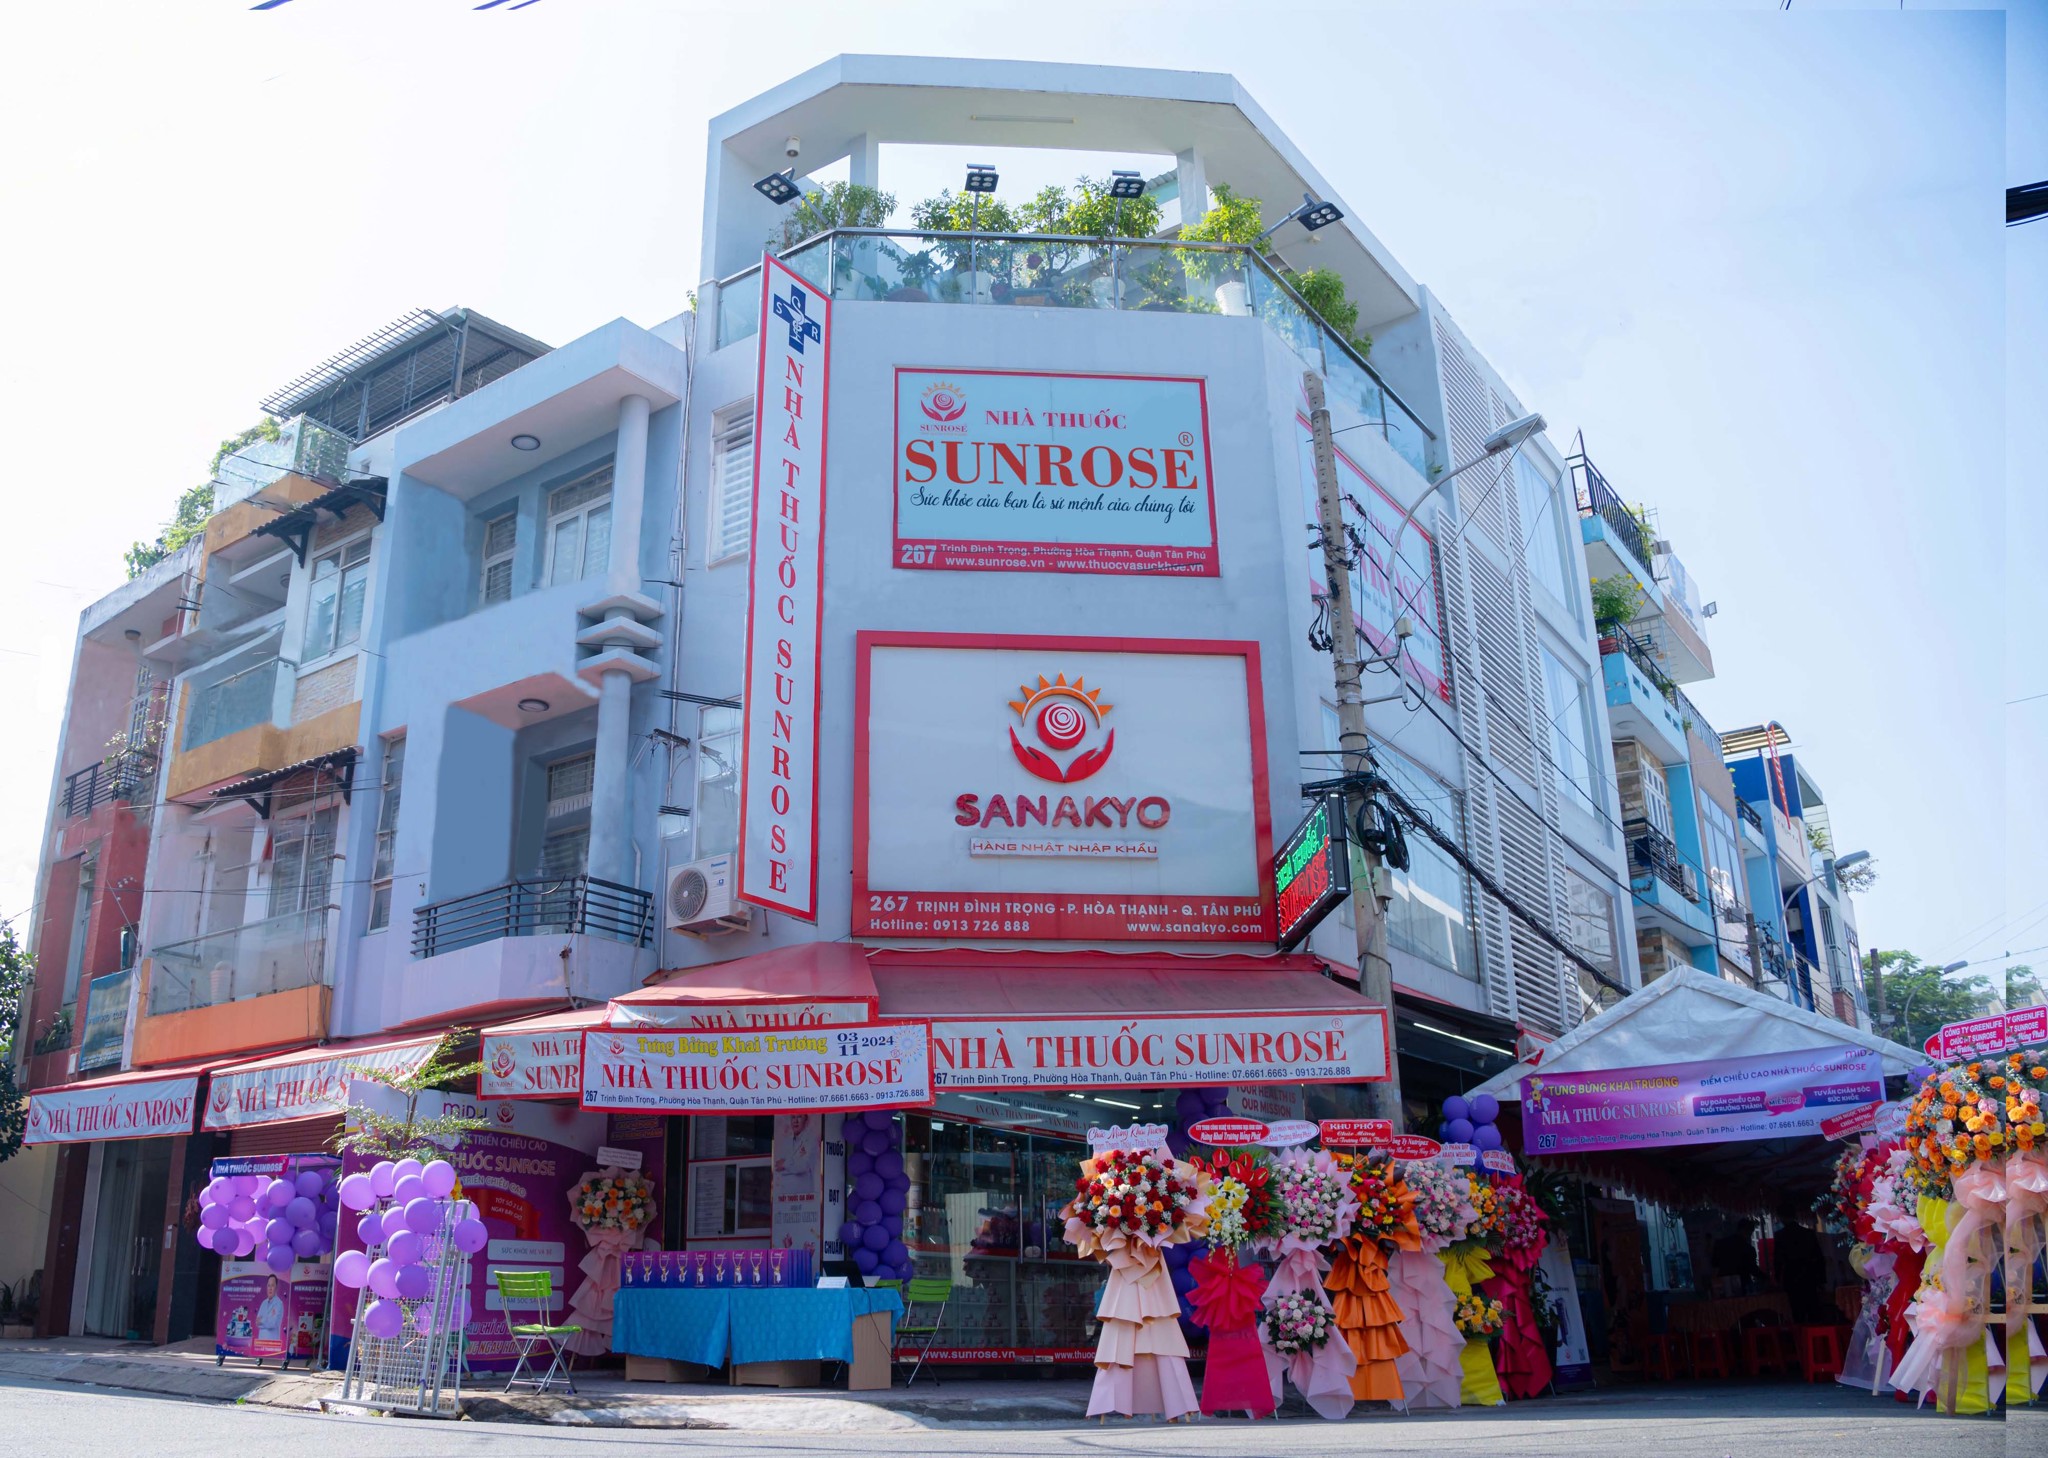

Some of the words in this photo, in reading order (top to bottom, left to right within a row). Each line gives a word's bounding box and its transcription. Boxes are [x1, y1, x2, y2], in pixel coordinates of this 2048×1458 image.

[783, 354, 806, 452] NHÀ
[986, 408, 1036, 428] NHÀ
[1043, 408, 1127, 431] THUỐC
[905, 438, 1198, 490] SUNROSE
[910, 486, 940, 508] Sức
[942, 488, 974, 508] khỏe
[976, 492, 1001, 508] của
[1004, 490, 1029, 510] bạn
[1032, 491, 1046, 509] là
[1050, 494, 1066, 510] sứ
[1067, 494, 1104, 512] mệnh
[1107, 494, 1131, 512] của
[1134, 494, 1173, 524] chúng
[1178, 495, 1196, 514] tôi
[776, 456, 802, 627] THUỐC
[901, 544, 937, 564] 267
[940, 544, 967, 554] Trịnh
[970, 544, 994, 554] Đình
[997, 545, 1030, 556] Trọng,
[1032, 545, 1072, 558] Phường
[1074, 546, 1094, 556] Hòa
[1097, 548, 1133, 559] Thạnh,
[1136, 548, 1162, 560] Quận
[1164, 549, 1183, 558] Tân
[1186, 548, 1206, 560] Phú
[945, 555, 1045, 569] www.sunrose.vn
[768, 637, 794, 895] SUNROSE
[954, 793, 1172, 829] SANAKYO
[972, 842, 1017, 852] HÀNG
[1021, 842, 1064, 854] NHẬT
[1068, 843, 1110, 855] NHẬP
[1115, 842, 1158, 854] KHẨU
[870, 895, 909, 912] 267
[916, 902, 960, 916] TRỊNH
[963, 898, 1002, 914] ĐÌNH
[1004, 902, 1056, 917] TRỌNG
[1067, 904, 1080, 916] P.
[1083, 899, 1116, 916] HÒA
[1118, 904, 1168, 918] THẠNH
[1181, 904, 1198, 917] Q.
[1200, 902, 1230, 917] TÂN
[1231, 901, 1260, 917] PHÚ
[871, 918, 929, 932] Hotline:
[933, 920, 969, 932] 0913
[972, 920, 1000, 932] 726
[1004, 920, 1030, 932] 888
[1126, 922, 1262, 936] www.sanakyo.com
[2012, 1010, 2045, 1023] GREENLIFE
[1961, 1026, 1970, 1034] TY
[1970, 1020, 2003, 1033] GREENLIFE
[2014, 1021, 2039, 1033] SUNROSE
[636, 1036, 676, 1057] Tưng
[721, 1036, 761, 1053] Khai
[764, 1035, 828, 1054] Trương
[837, 1032, 858, 1042] 03
[862, 1036, 895, 1047] 2024
[932, 1028, 1015, 1070] NHÀ
[1026, 1021, 1164, 1068] THUỐC
[1174, 1029, 1347, 1066] SUNROSE
[1972, 1032, 1997, 1042] SUNROSE
[531, 1036, 560, 1058] NHÀ
[839, 1044, 860, 1056] 11
[524, 1064, 579, 1090] SUNR
[602, 1060, 654, 1089] NHÀ
[660, 1056, 758, 1090] THUỐC
[766, 1058, 903, 1090] SUNROSE
[951, 1074, 974, 1085] Trịnh
[1001, 1074, 1030, 1086] Trọng,
[1033, 1072, 1069, 1084] Phường
[1071, 1072, 1088, 1082] Hòa
[1090, 1072, 1122, 1084] Thạnh,
[1124, 1072, 1148, 1083] Quận
[1150, 1070, 1167, 1080] Tân
[1169, 1070, 1187, 1080] Phú
[1195, 1070, 1230, 1080] Hotline:
[1231, 1068, 1288, 1079] 07.6661.6663
[1295, 1066, 1351, 1078] 0913.726.888
[1751, 1070, 1768, 1079] CAO
[1770, 1064, 1790, 1076] NHÀ
[1791, 1063, 1822, 1073] THUỐC
[1823, 1063, 1866, 1072] SUNROSE
[234, 1079, 268, 1114] NHÀ
[274, 1065, 336, 1109] THUỐC
[1258, 1086, 1288, 1102] HEALTH
[1609, 1082, 1634, 1092] KHAI
[586, 1090, 598, 1102] 267
[600, 1094, 616, 1104] Trịnh
[635, 1095, 656, 1106] Trọng,
[702, 1096, 728, 1106] Thạnh,
[730, 1096, 749, 1106] Quận
[750, 1096, 766, 1105] Tân
[768, 1095, 782, 1104] Phú
[788, 1096, 818, 1104] Hotline:
[819, 1093, 870, 1103] 07.6661.6663
[876, 1088, 925, 1100] 0913.726.888
[46, 1102, 71, 1134] NHÀ
[76, 1094, 122, 1132] THUỐC
[124, 1096, 192, 1128] SUNROSE
[1242, 1098, 1258, 1112] OUR
[1260, 1101, 1292, 1118] MISSION
[1542, 1104, 1571, 1126] NHÀ
[1572, 1099, 1620, 1124] THUỐC
[1623, 1098, 1688, 1120] SUNROSE
[1354, 1120, 1374, 1130] PHỐ
[1740, 1124, 1767, 1132] Hotline:
[528, 1140, 548, 1152] CAO
[826, 1141, 844, 1156] THUỐC
[1538, 1134, 1558, 1150] 267
[495, 1155, 556, 1176] SUNROSE
[829, 1189, 840, 1206] ĐẠT
